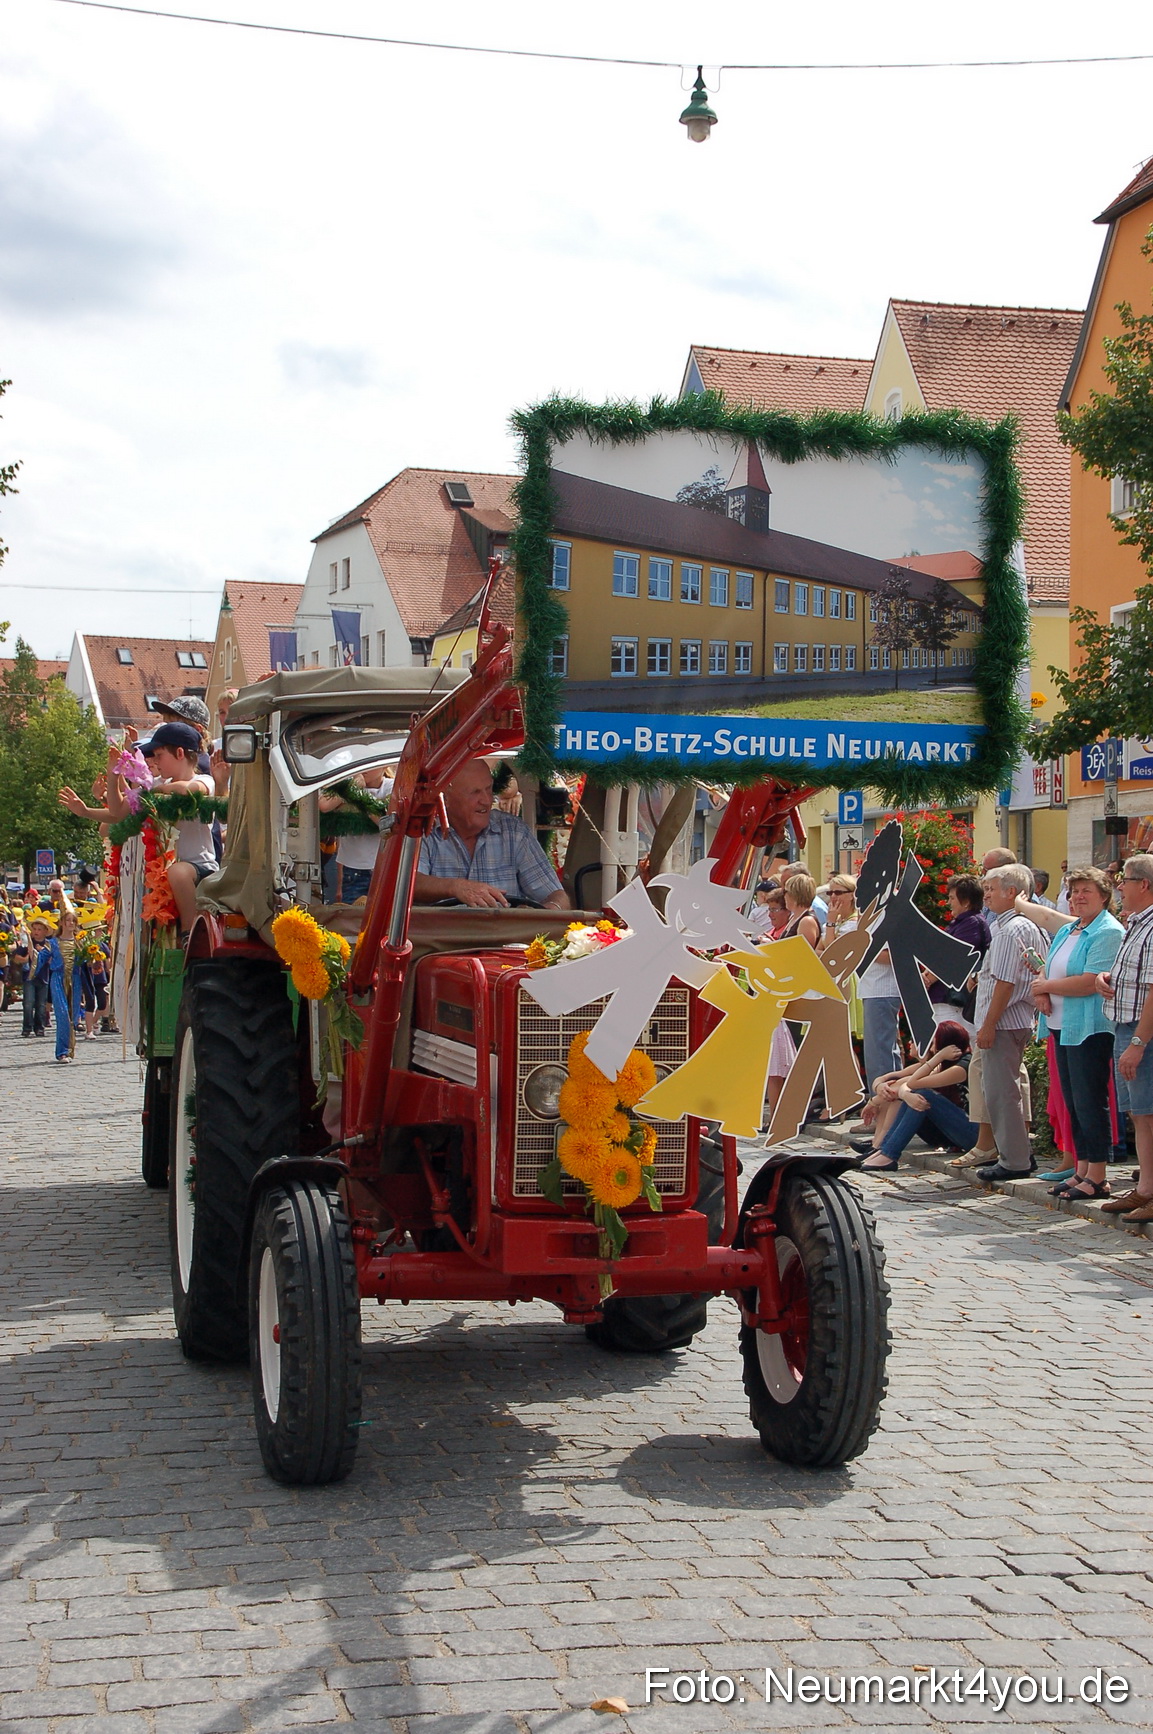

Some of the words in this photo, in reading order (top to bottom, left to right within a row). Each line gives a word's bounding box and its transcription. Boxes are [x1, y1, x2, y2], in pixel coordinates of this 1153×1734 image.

[552, 724, 817, 757] THEO-BETZ-SCHULE
[827, 733, 976, 762] NEUMARKT
[1107, 744, 1114, 777] P
[1133, 766, 1153, 776] Reis
[844, 795, 858, 821] P
